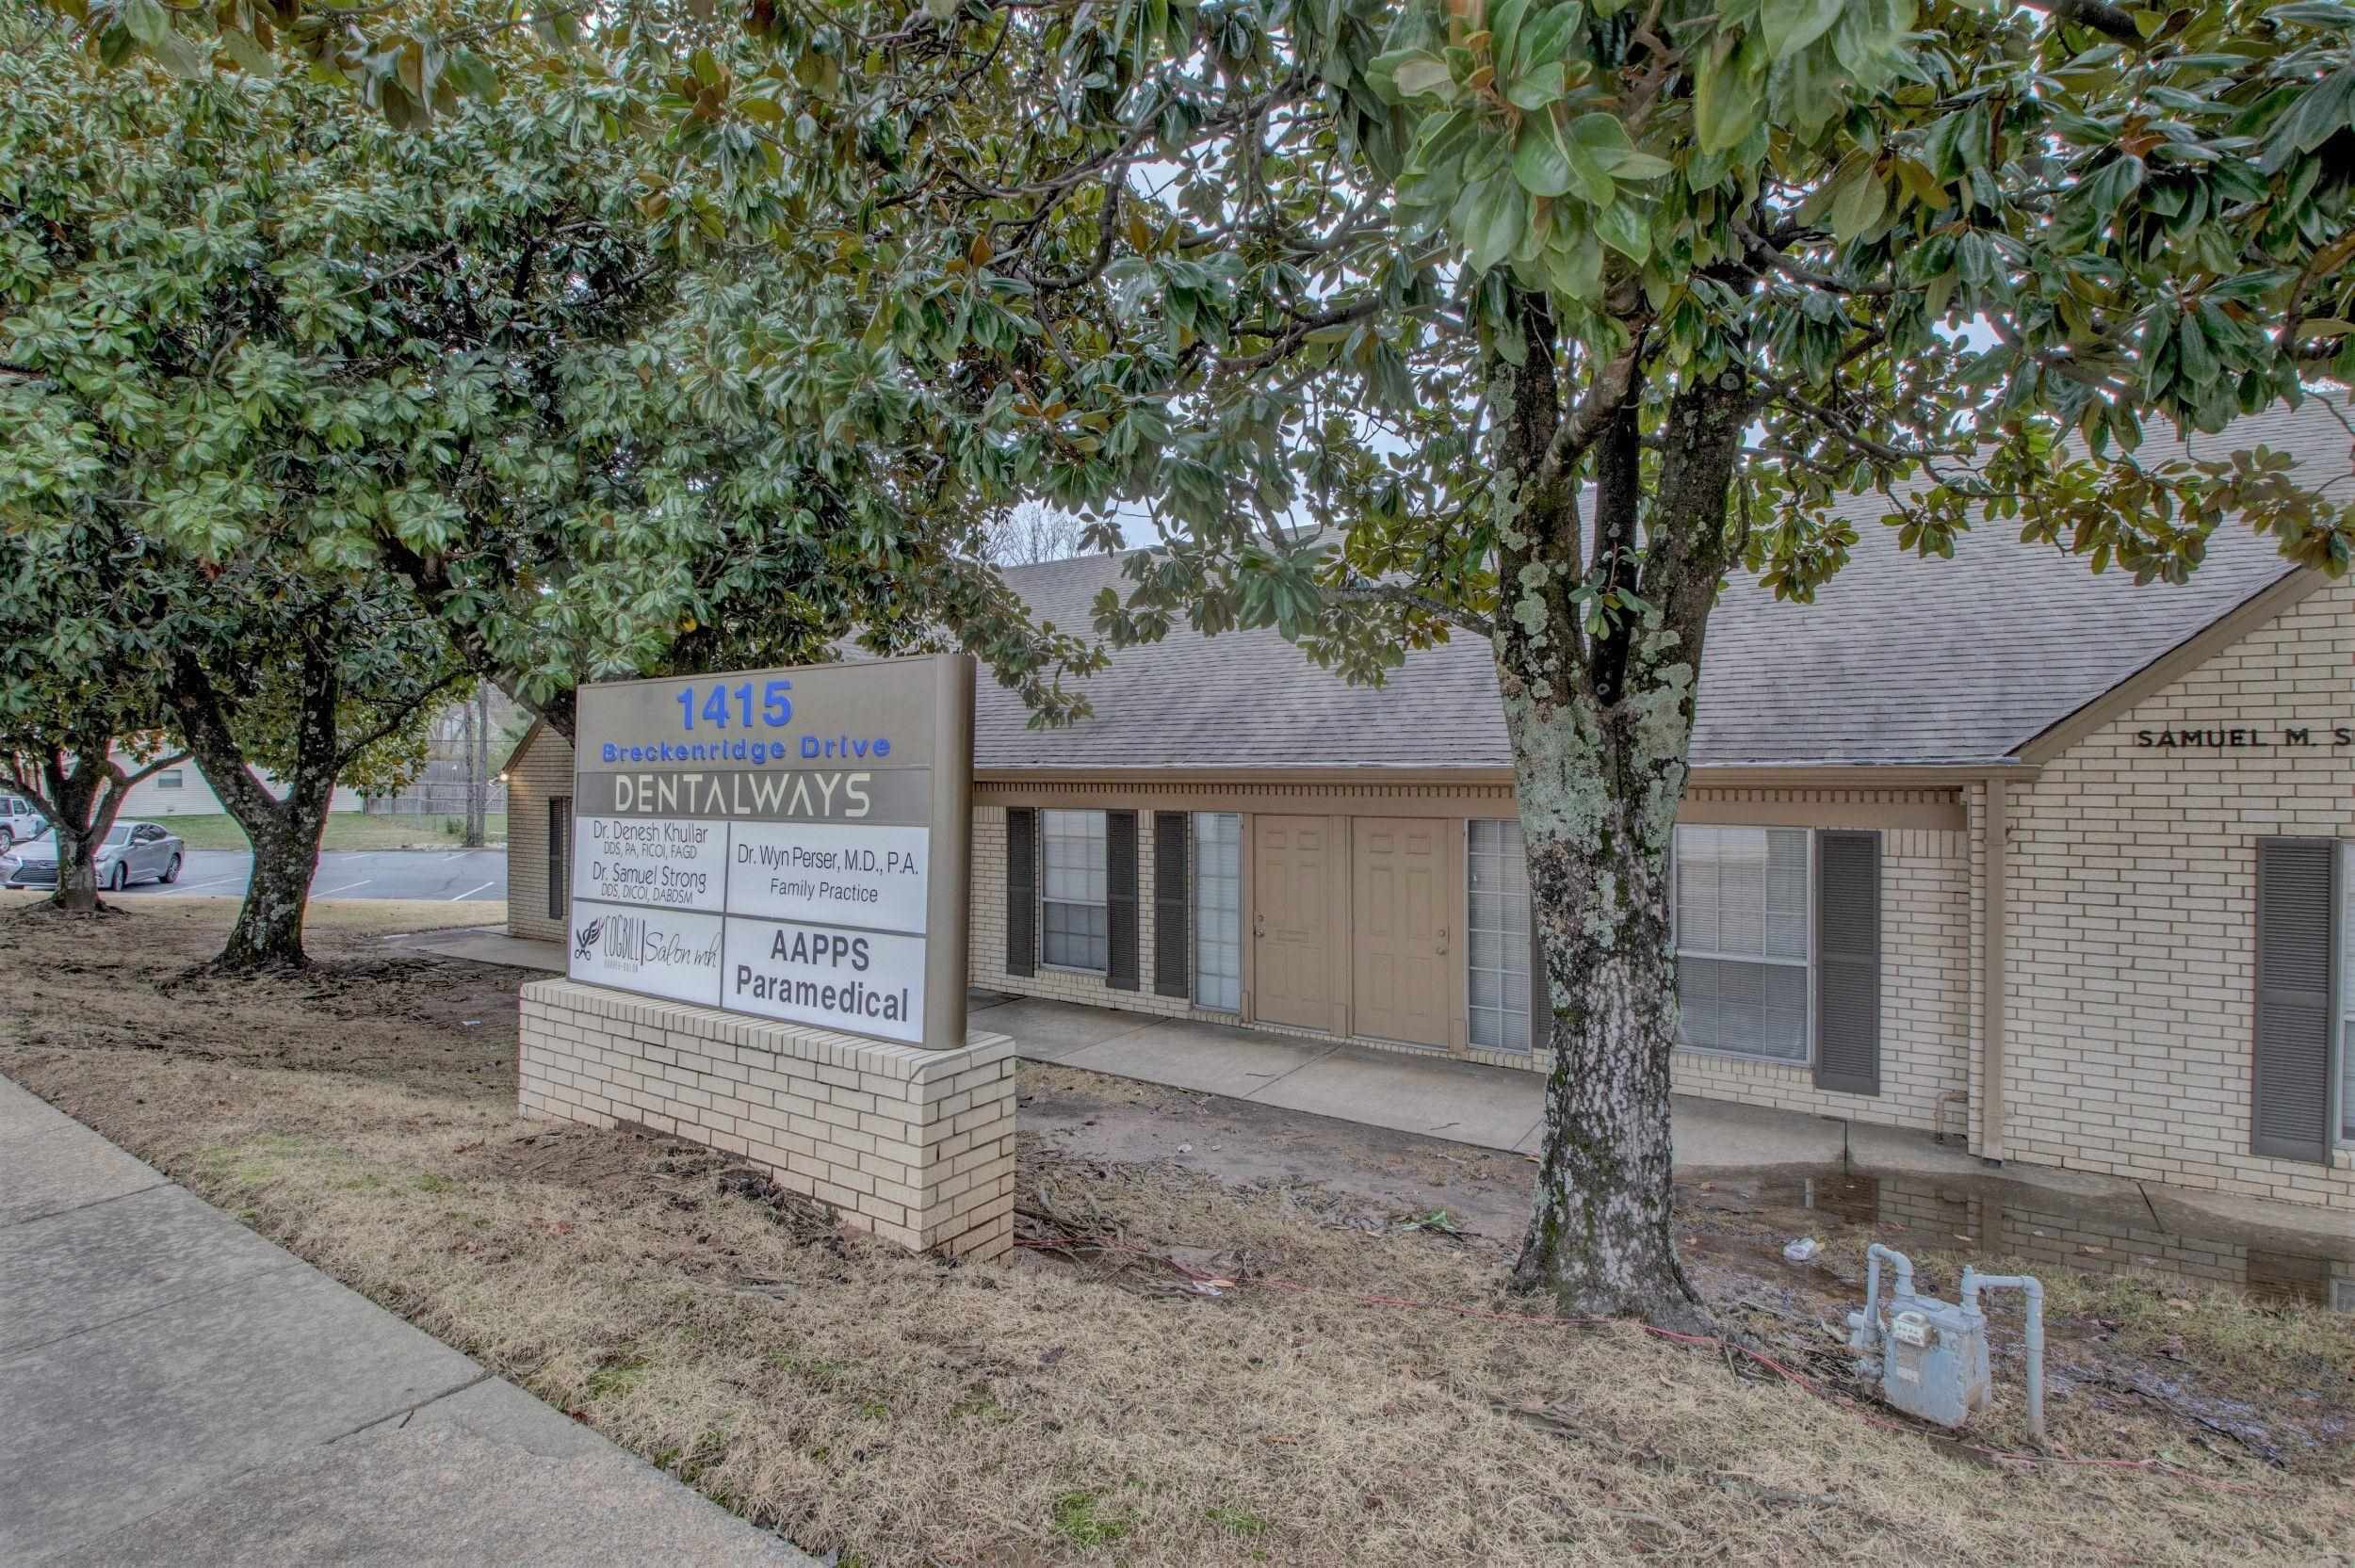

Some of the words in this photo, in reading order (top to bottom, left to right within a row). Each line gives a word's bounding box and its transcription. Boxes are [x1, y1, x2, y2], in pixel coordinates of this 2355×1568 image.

[677, 679, 794, 730] 1415
[602, 736, 787, 765] Breckenridge
[800, 733, 891, 759] Drive
[2136, 729, 2267, 748] SAMUEL
[2285, 727, 2317, 747] M.
[614, 772, 871, 817] DENTALWAYS
[593, 820, 609, 839] Dr.
[613, 821, 660, 841] Denesh
[664, 822, 709, 844] Khullar
[604, 841, 624, 859] DDS,
[625, 843, 640, 858] PA,
[671, 845, 697, 860] FAGD
[738, 843, 756, 865] Dr.
[759, 845, 789, 870] Wyn
[792, 847, 840, 873] Perser,
[844, 849, 884, 876] M.D.,
[887, 851, 919, 875] P.A.
[593, 861, 609, 881] Dr.
[612, 863, 658, 885] Samuel
[661, 865, 706, 894] Strong
[601, 882, 621, 899] DDS,
[771, 878, 816, 901] Family
[819, 881, 879, 903] Practice
[644, 931, 690, 966] Salon
[770, 929, 869, 972] AAPPS
[736, 964, 909, 1023] Paramedical
